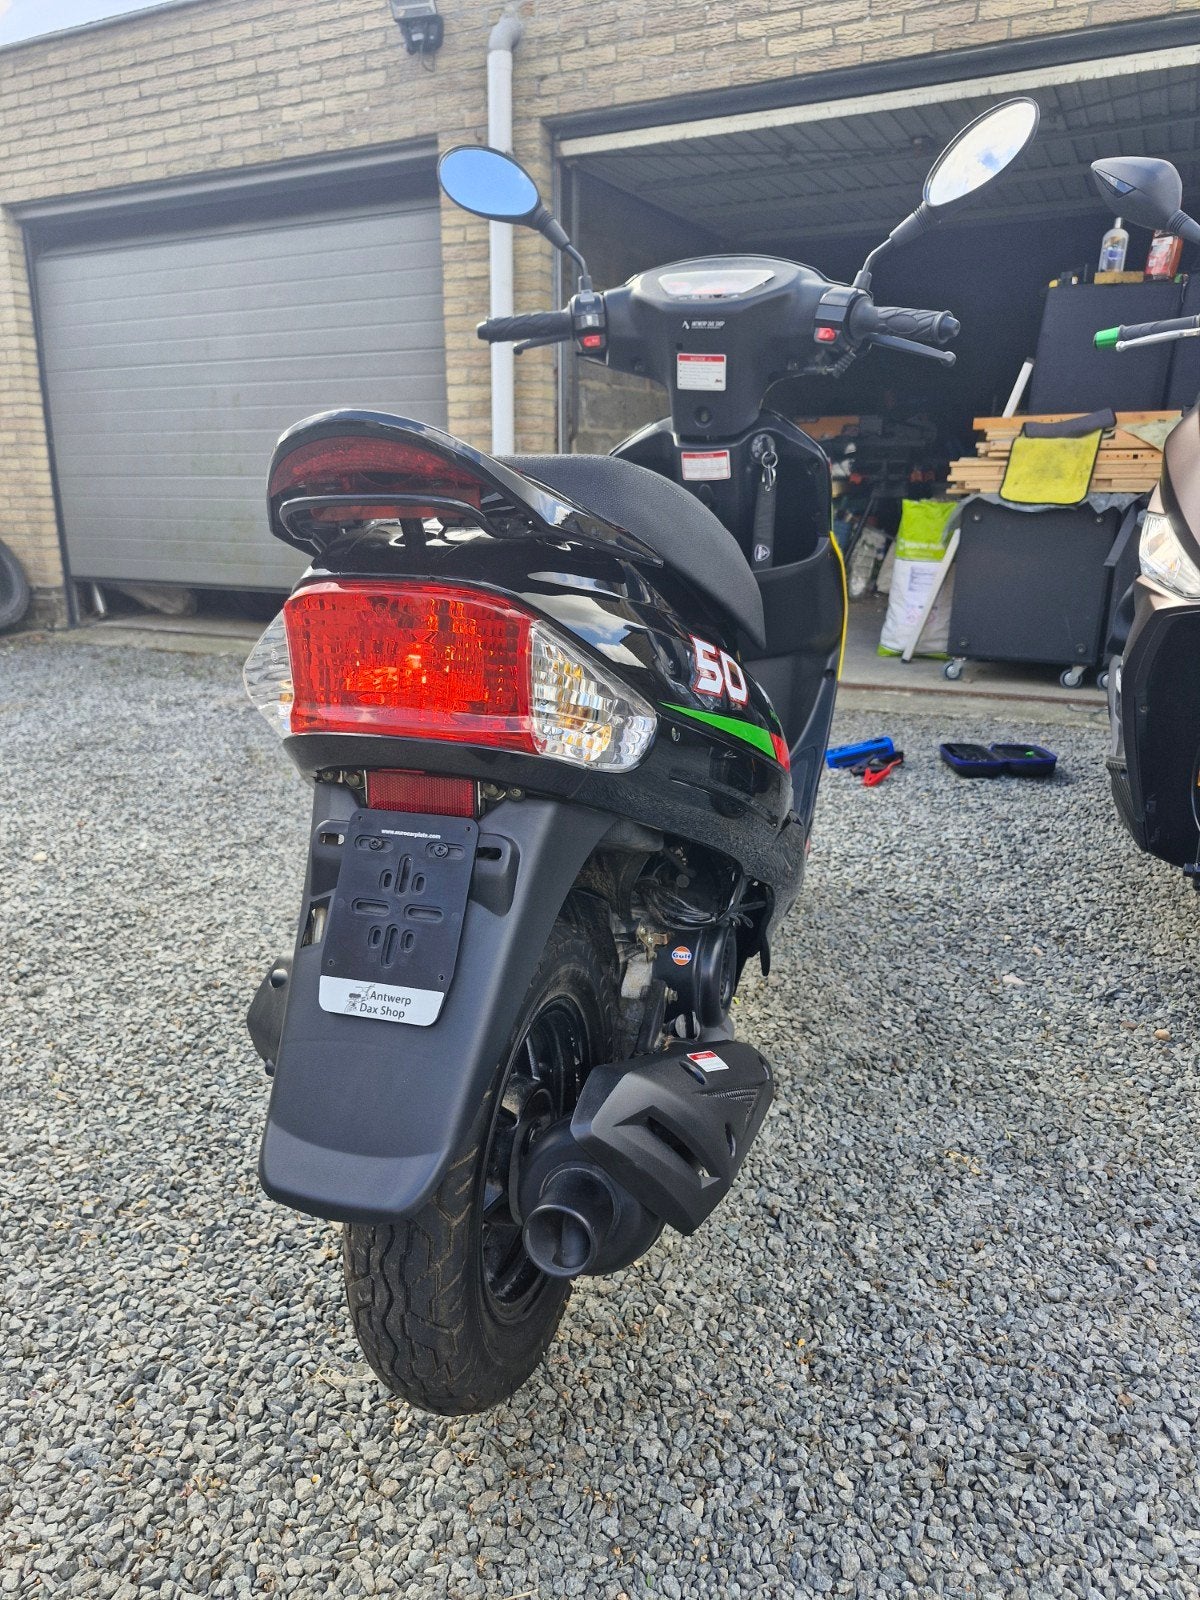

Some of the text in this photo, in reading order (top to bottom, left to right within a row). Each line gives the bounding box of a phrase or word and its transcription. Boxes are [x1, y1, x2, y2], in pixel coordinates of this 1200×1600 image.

[689, 634, 750, 707] 50
[381, 829, 441, 840] www.eurocarplate.com
[672, 952, 691, 960] Gulf
[370, 990, 412, 1007] Antwerp
[359, 1002, 405, 1020] Dax Shop
